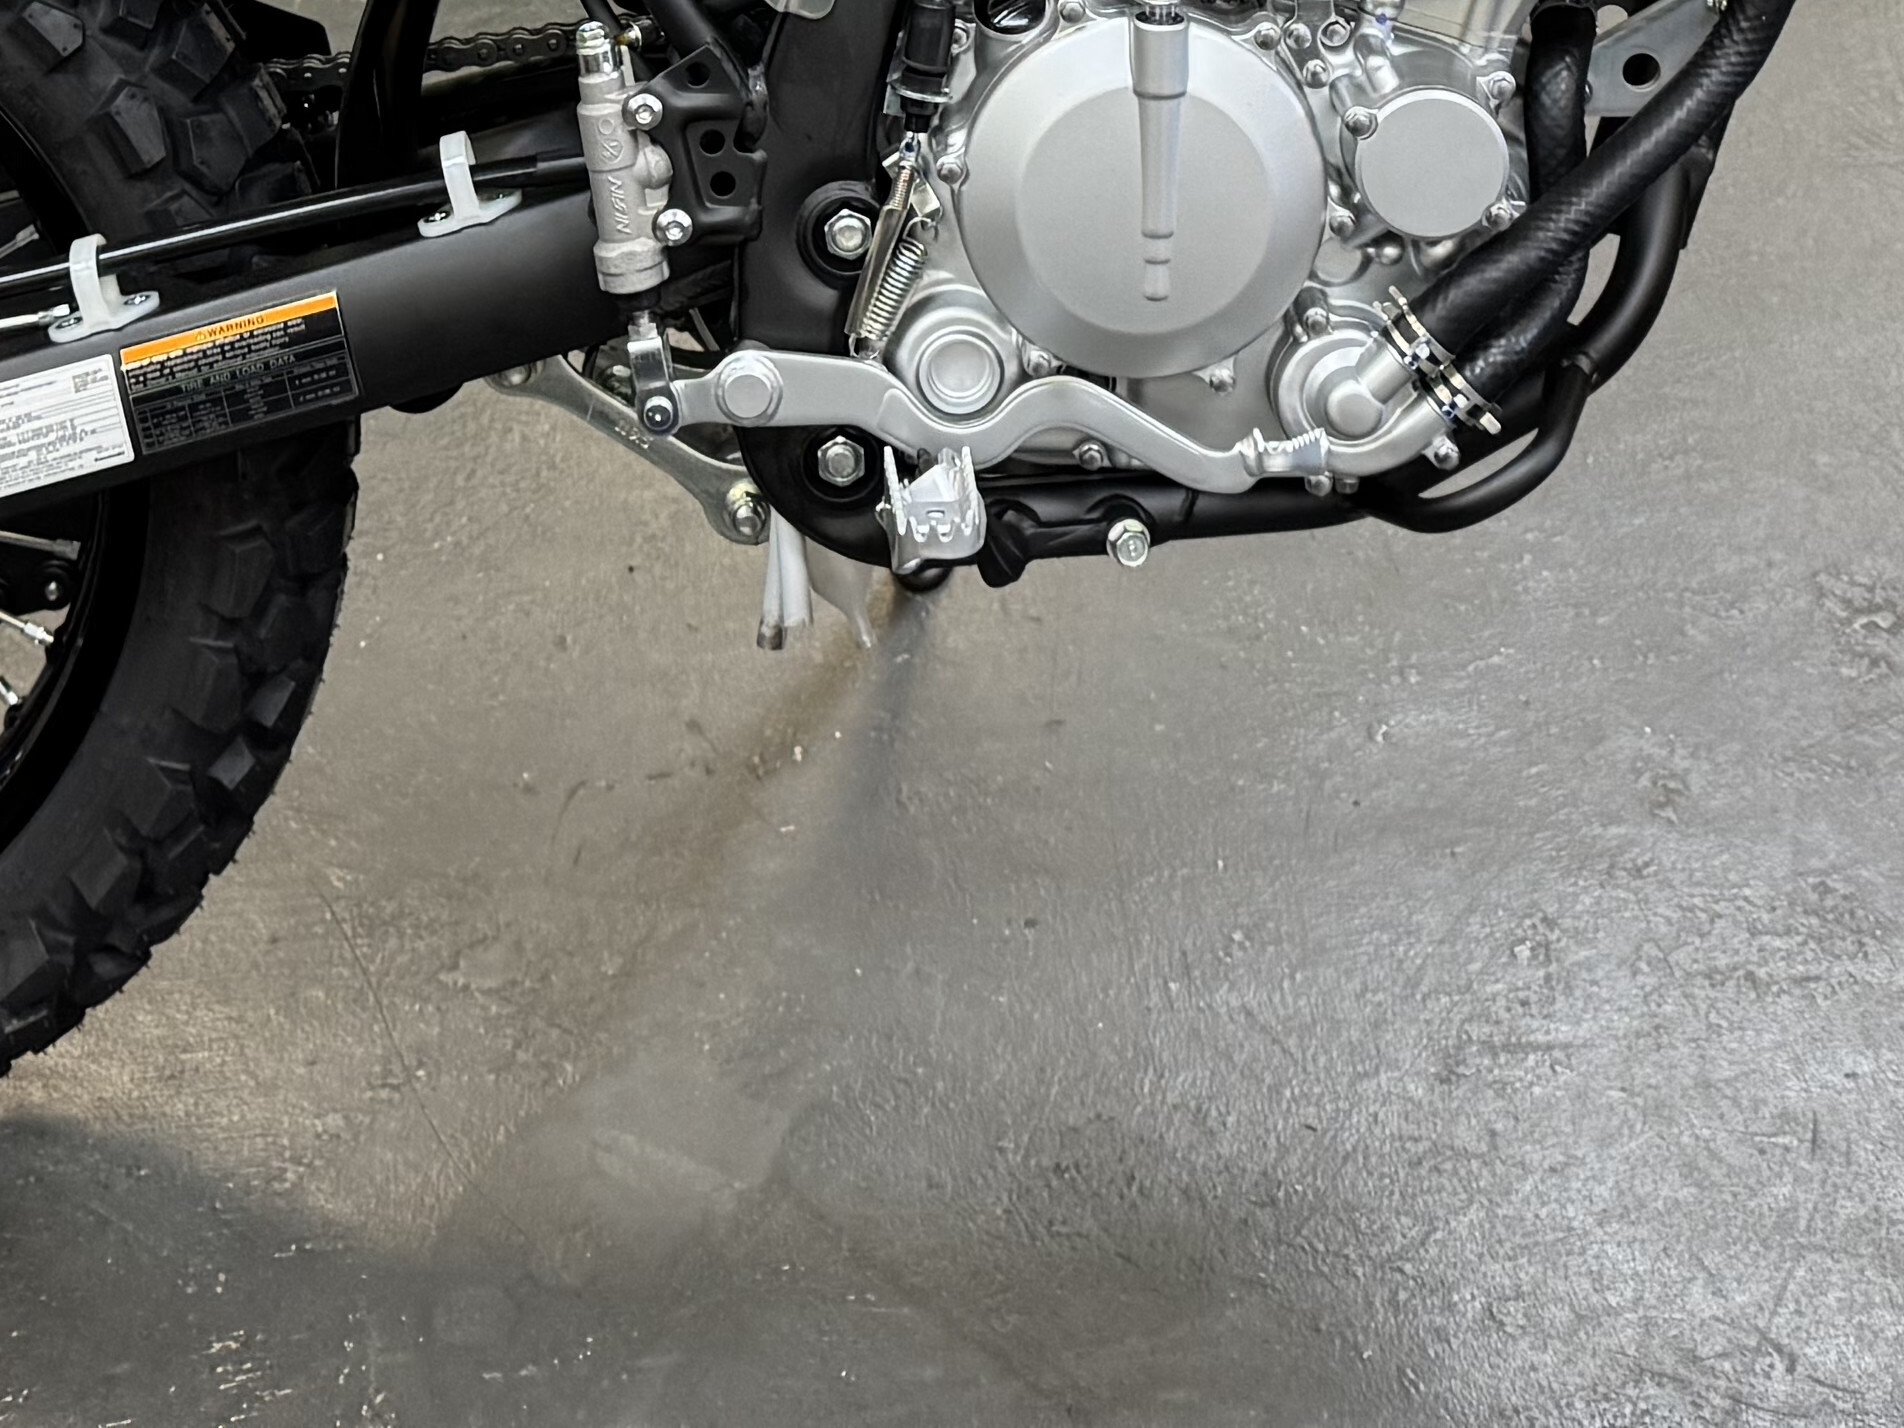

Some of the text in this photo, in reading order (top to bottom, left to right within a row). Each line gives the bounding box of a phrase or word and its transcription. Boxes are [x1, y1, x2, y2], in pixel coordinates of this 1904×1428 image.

[207, 314, 265, 339] WARNING
[181, 354, 297, 393] TIRE AND LOAD DATA
